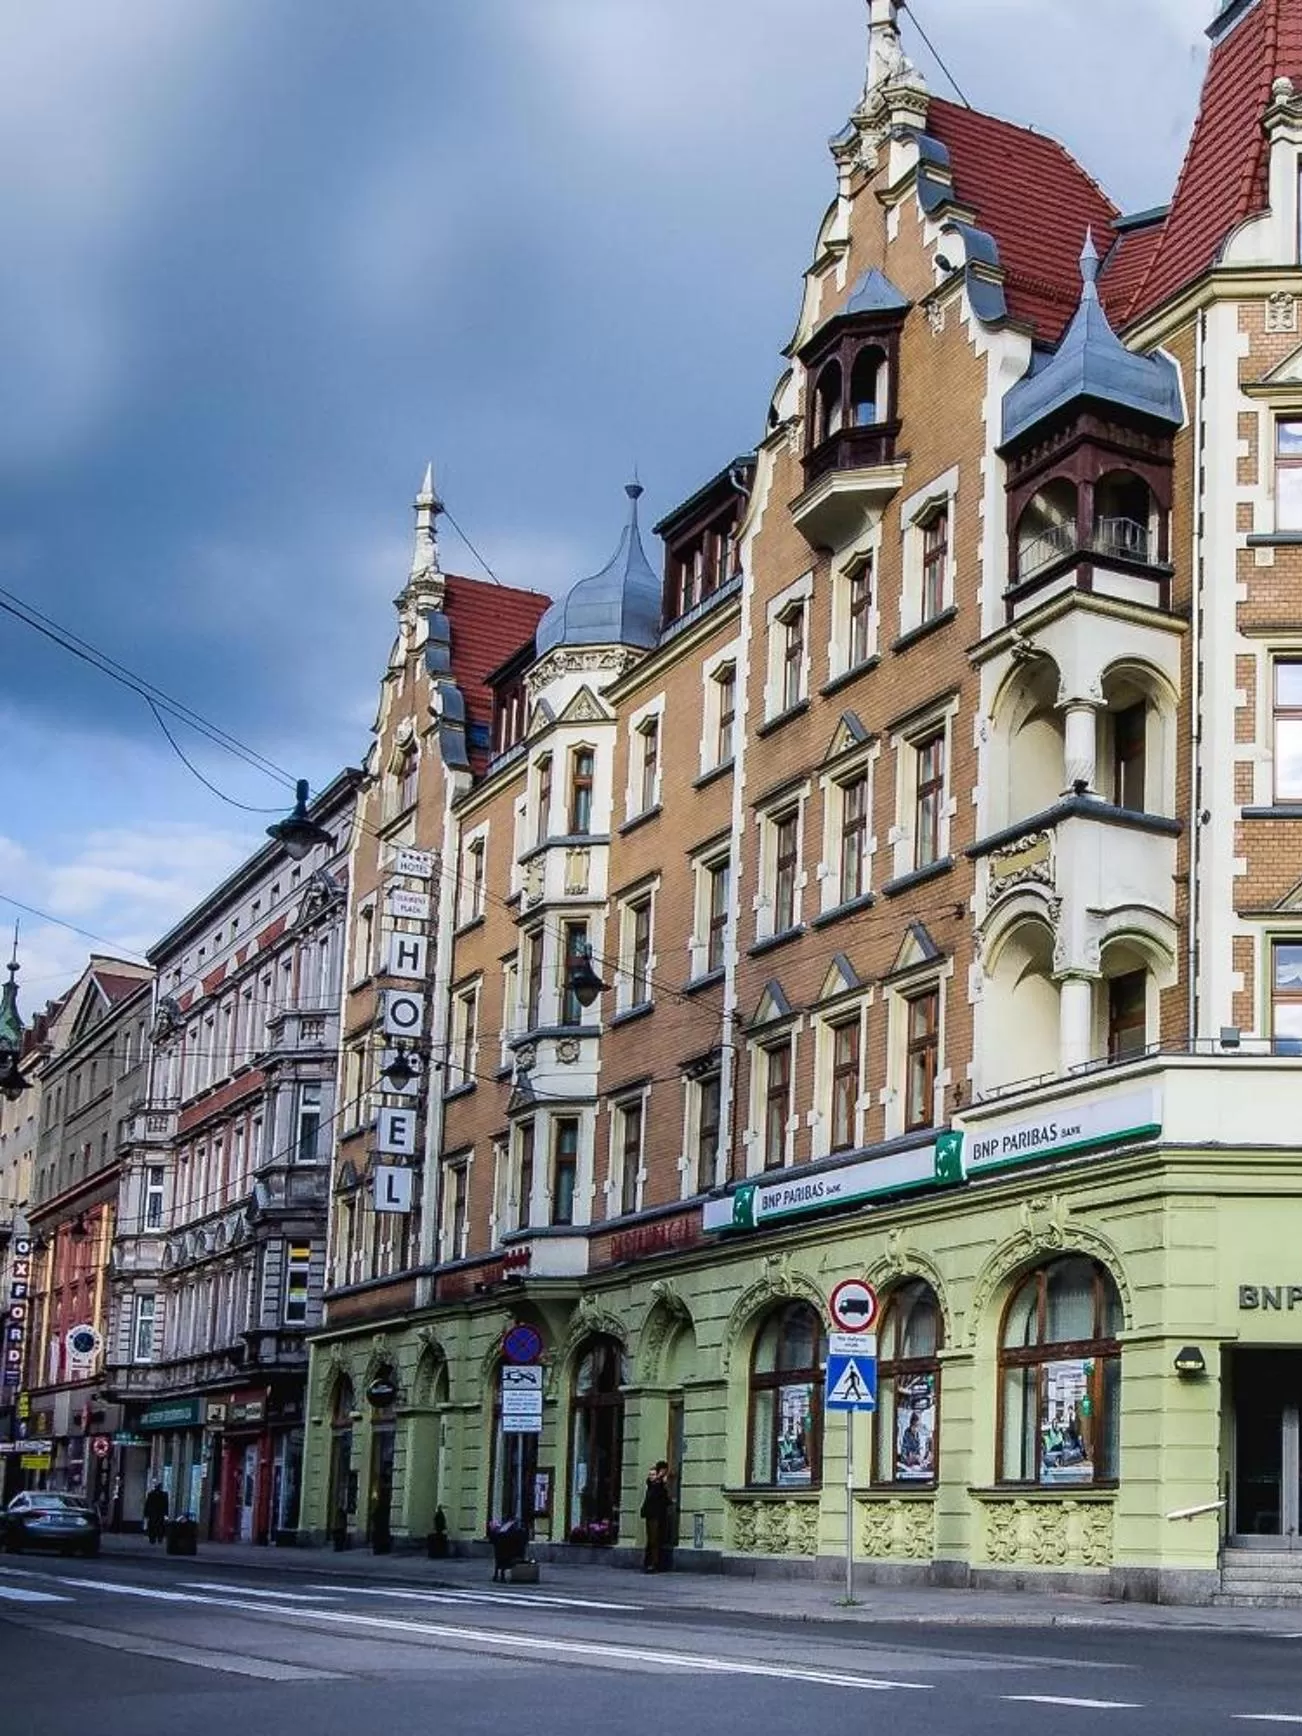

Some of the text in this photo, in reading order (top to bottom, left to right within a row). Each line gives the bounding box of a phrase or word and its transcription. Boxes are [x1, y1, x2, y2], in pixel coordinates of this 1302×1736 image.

[400, 861, 428, 874] HOTEL
[386, 940, 419, 1204] HOEL
[973, 1139, 999, 1161] BNP
[1003, 1123, 1058, 1152] PARIBAS
[762, 1193, 782, 1210] BNP
[784, 1181, 824, 1205] PARIBAS
[8, 1242, 29, 1360] OXFORD
